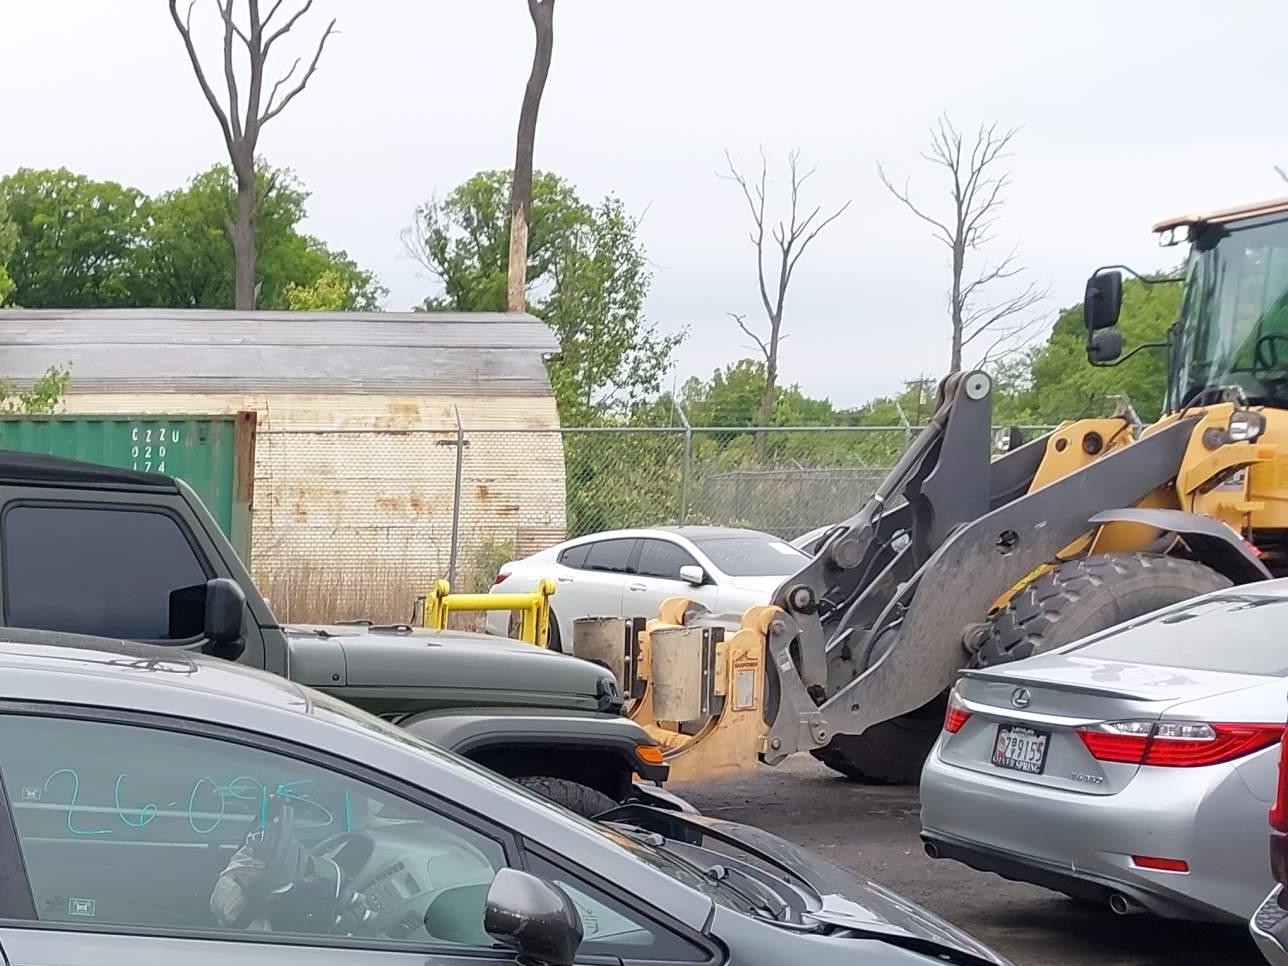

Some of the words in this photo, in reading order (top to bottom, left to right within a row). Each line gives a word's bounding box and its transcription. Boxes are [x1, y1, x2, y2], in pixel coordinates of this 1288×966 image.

[132, 428, 179, 442] CZZU
[132, 446, 166, 458] 020
[1015, 760, 1040, 773] SPRING
